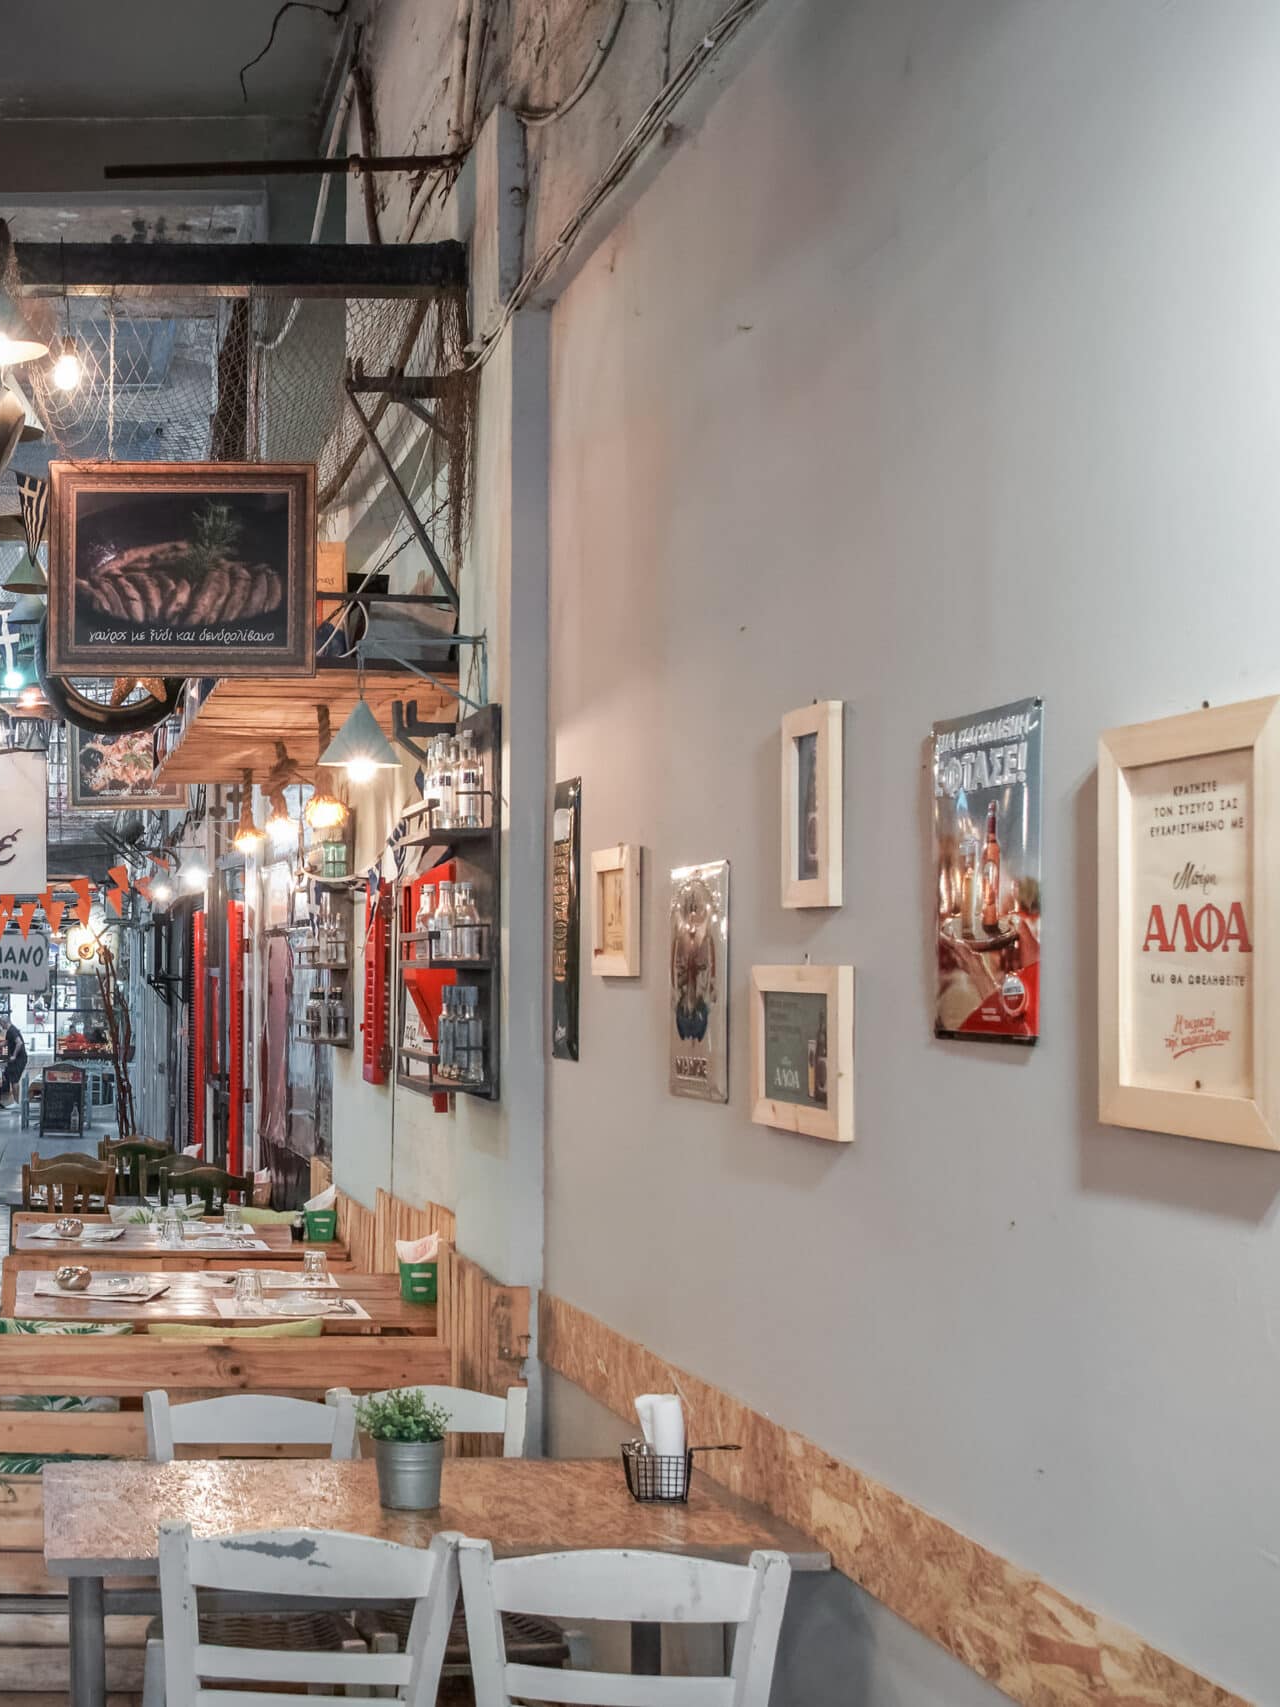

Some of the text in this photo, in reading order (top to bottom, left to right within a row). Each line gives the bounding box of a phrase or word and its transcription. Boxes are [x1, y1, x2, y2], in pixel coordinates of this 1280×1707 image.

[89, 628, 127, 644] γαύρος
[131, 631, 146, 643] με
[176, 631, 196, 642] και
[199, 627, 276, 645] δενδρολίβανο
[1154, 806, 1174, 818] ΤΟΝ
[1219, 797, 1239, 811] ΣΑΣ
[1231, 816, 1245, 829] ΜΕ
[1142, 901, 1253, 952] ΑΛΦΑ
[1169, 973, 1183, 985] ΘΑ
